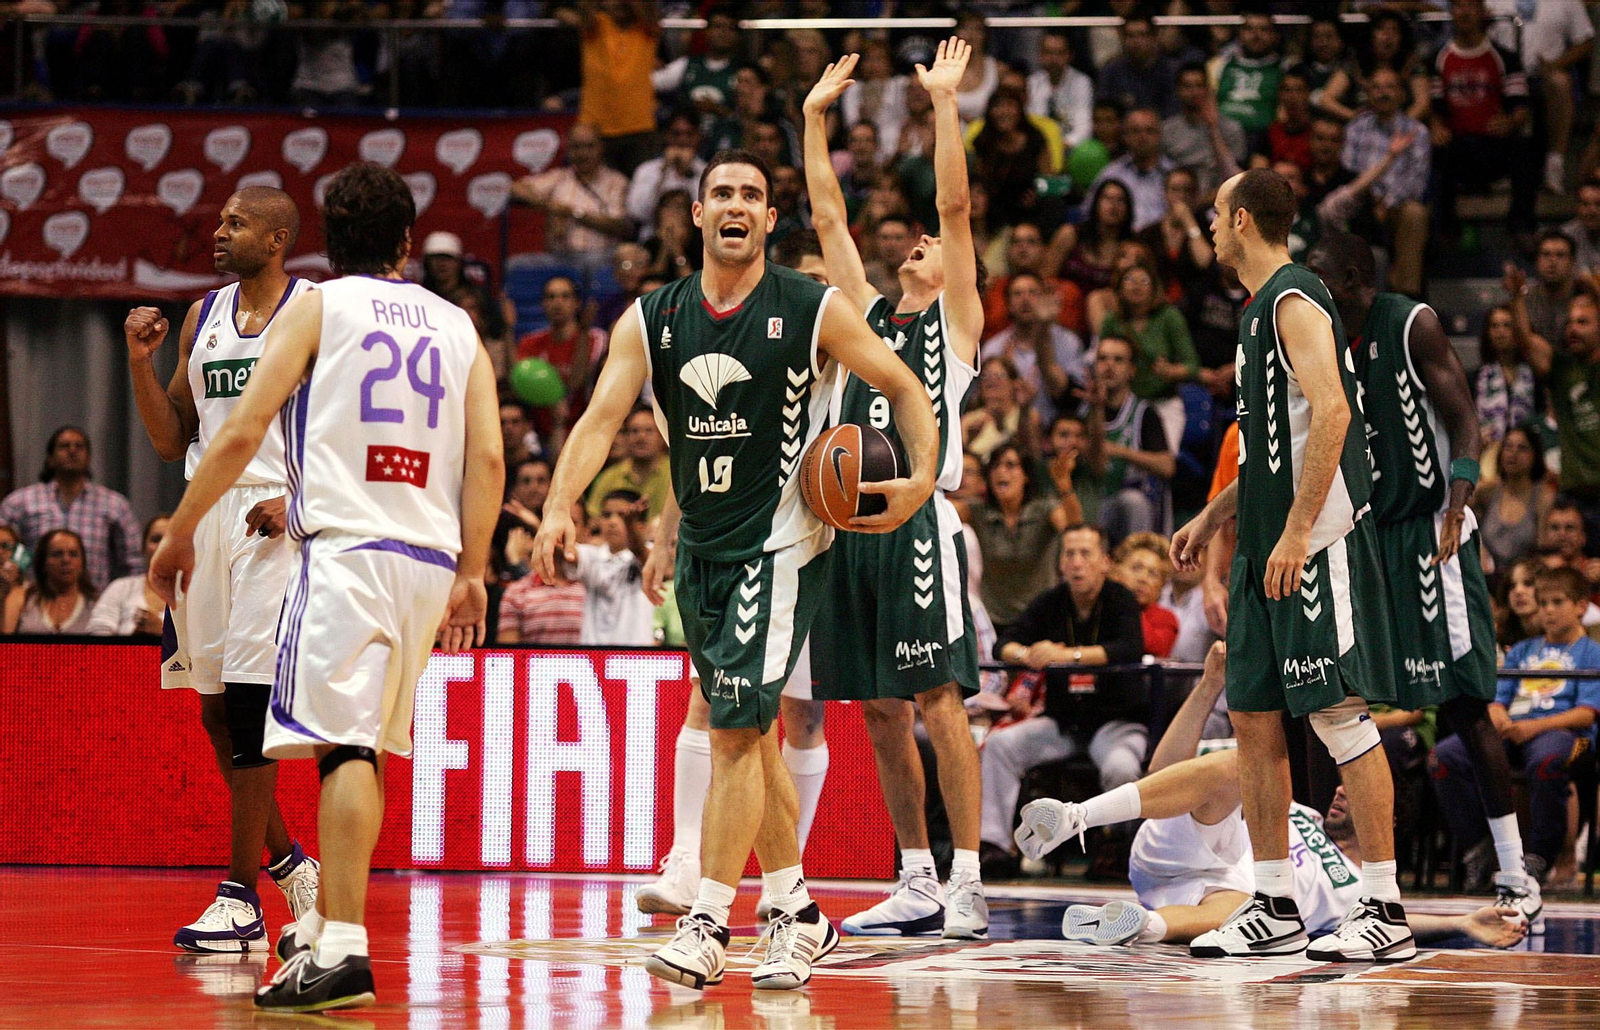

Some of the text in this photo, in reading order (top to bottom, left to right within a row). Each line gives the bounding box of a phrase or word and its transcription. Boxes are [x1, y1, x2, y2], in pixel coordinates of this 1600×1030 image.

[372, 299, 438, 331] RAUL
[360, 330, 446, 429] 24
[688, 412, 748, 434] Unicaja
[411, 653, 684, 870] FIAT
